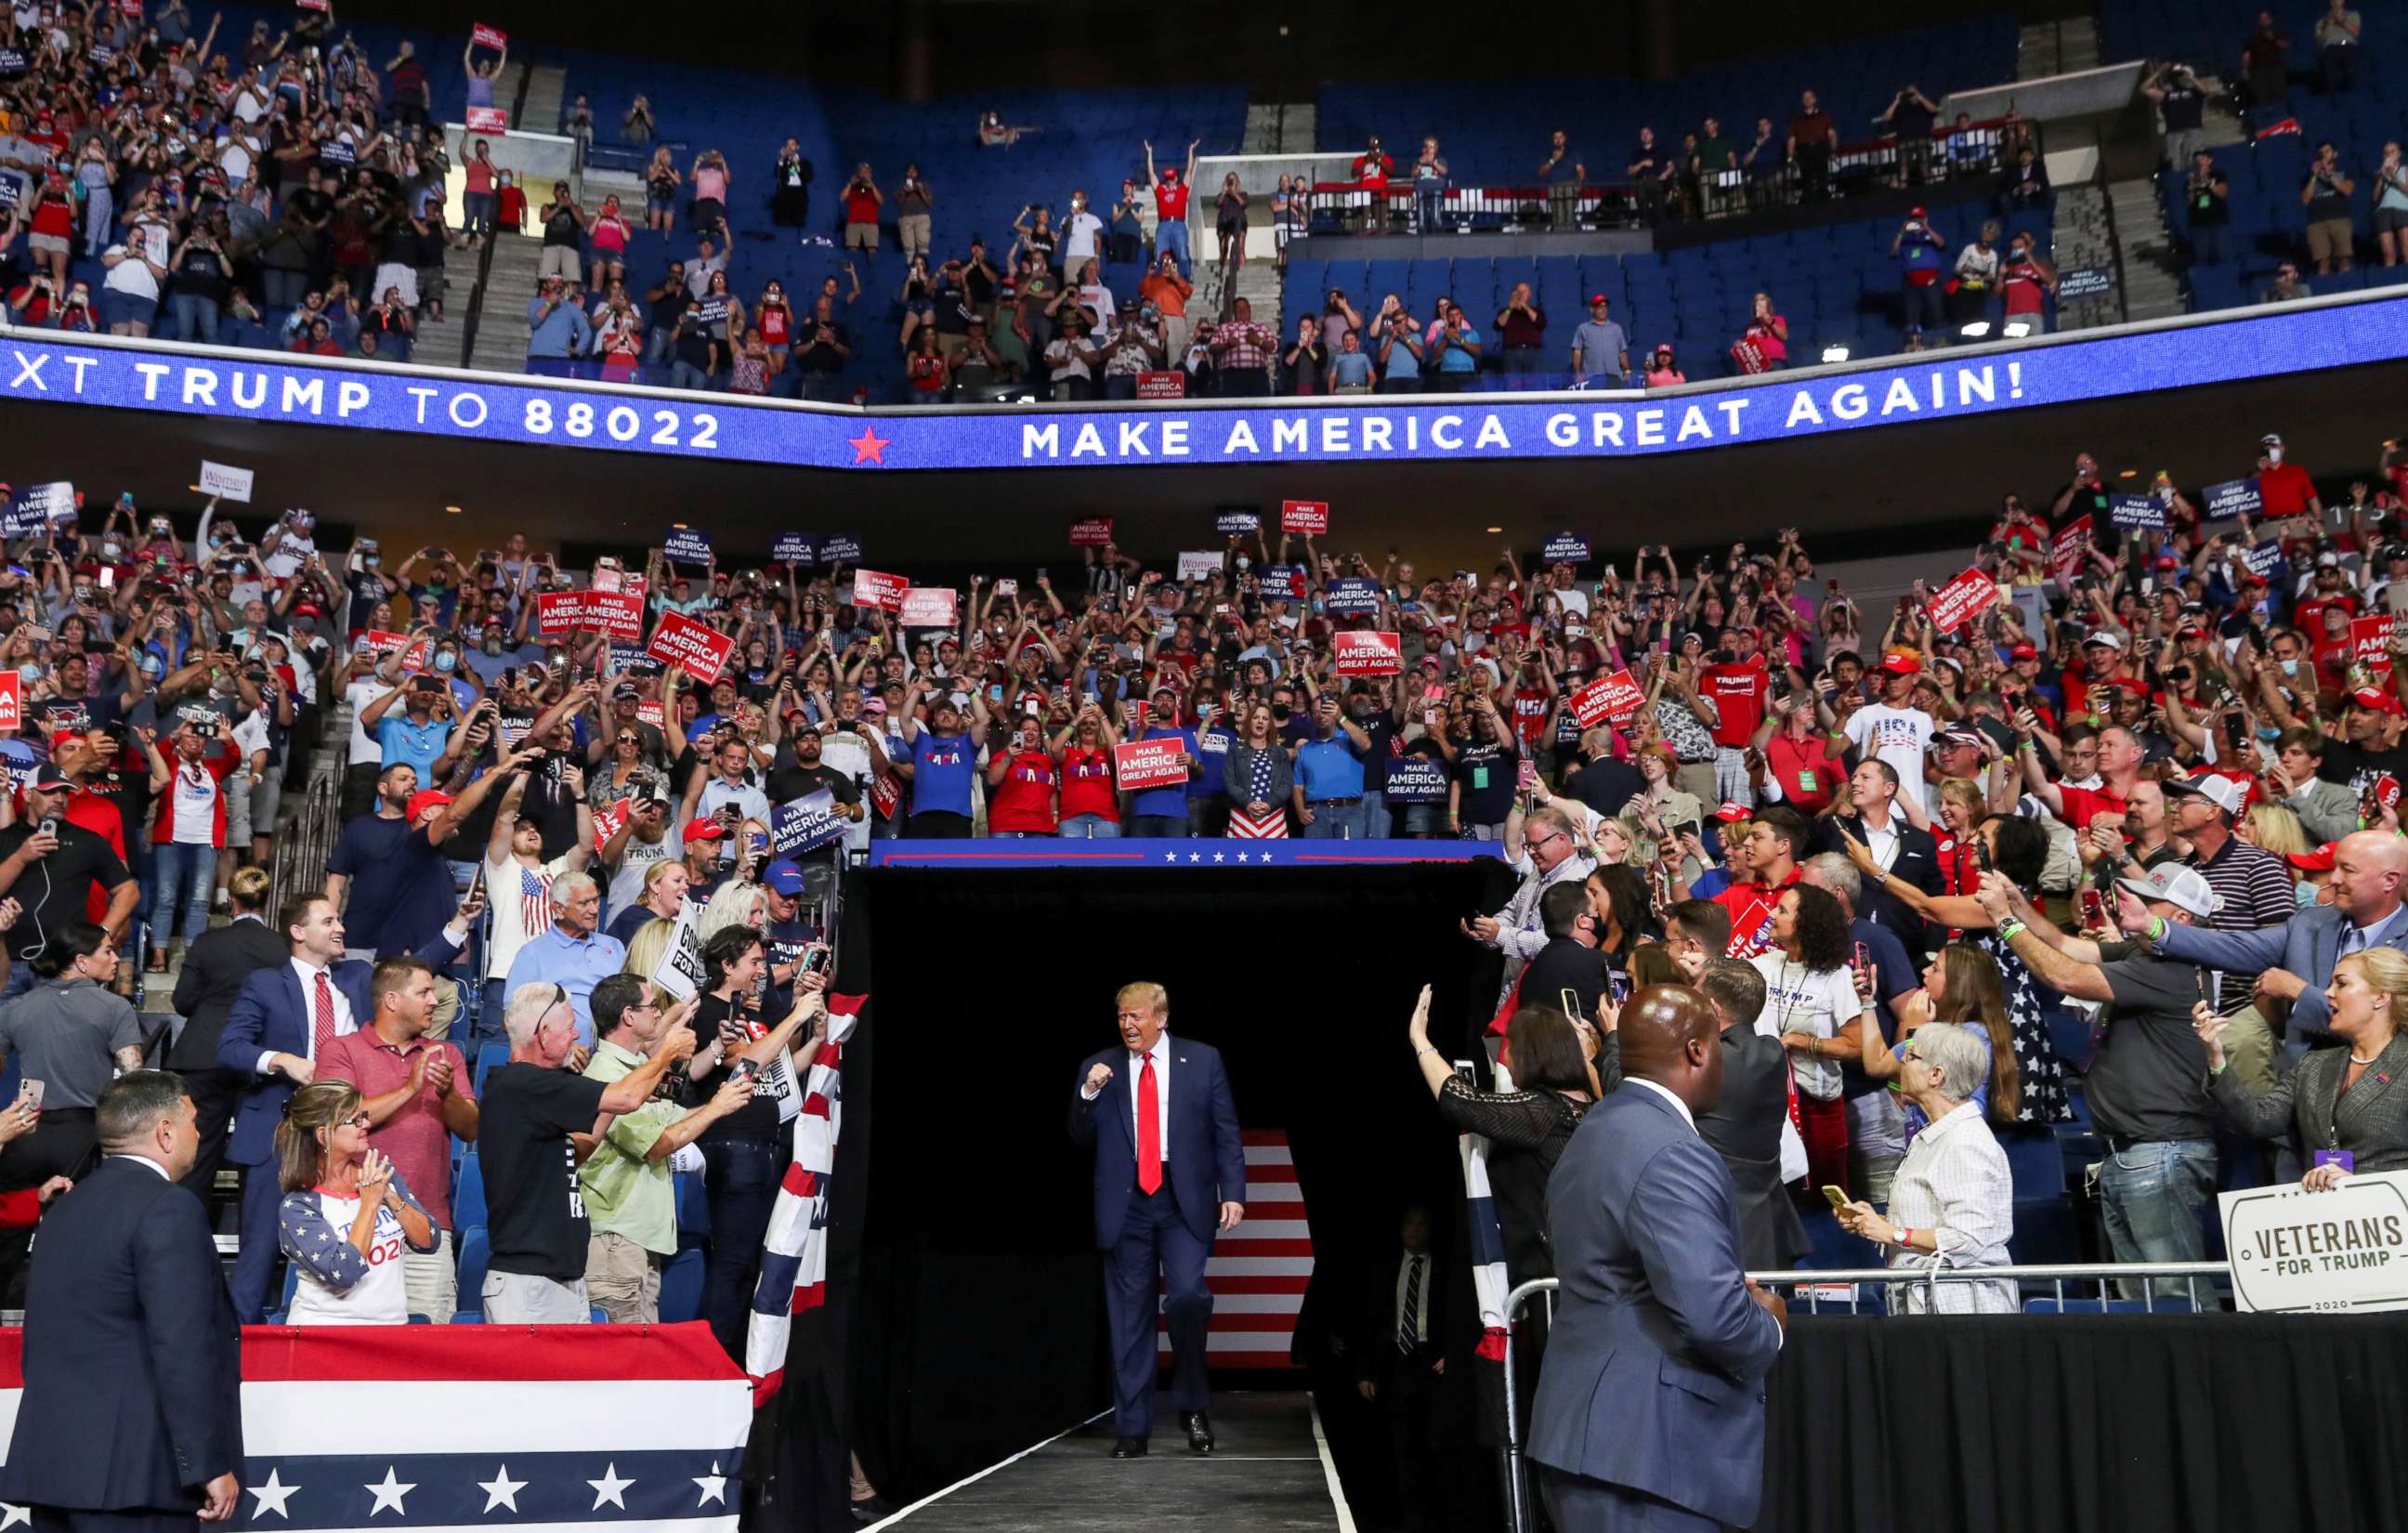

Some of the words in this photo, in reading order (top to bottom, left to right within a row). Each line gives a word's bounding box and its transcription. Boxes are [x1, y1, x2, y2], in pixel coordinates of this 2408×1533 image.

[2060, 276, 2107, 289] AMERICA
[1140, 382, 1182, 391] AMERICA
[135, 362, 370, 417] TRUMP
[407, 387, 488, 428] TO
[524, 399, 719, 449] 88022
[1022, 420, 1190, 458] MAKE
[1224, 414, 1512, 454] AMERICA
[1545, 398, 1750, 448] GREAT
[1785, 360, 2024, 428] AGAIN!
[205, 469, 247, 488] Women
[2127, 499, 2149, 507] MAKE
[2209, 491, 2259, 510] AMERICA
[1285, 512, 1325, 521] AMERICA
[2113, 504, 2164, 518] AMERICA
[1217, 515, 1258, 524] AMERICA
[1072, 524, 1108, 532] AMERICA
[679, 533, 700, 542] MAKE
[829, 537, 846, 545] MAKE
[665, 538, 711, 552] AMERICA
[773, 544, 812, 553] AMERICA
[820, 543, 859, 556] AMERICA
[1545, 543, 1587, 552] AMERICA
[664, 547, 687, 557] GREAT
[688, 550, 711, 558] AGAIN
[1182, 559, 1219, 568] Women
[871, 577, 893, 586] MAKE
[1329, 590, 1375, 600] AMERICA
[1938, 581, 1964, 601] MAKE
[556, 597, 578, 606] MAKE
[600, 597, 625, 608] MAKE
[1932, 577, 1987, 620] AMERICA
[542, 605, 582, 618] AMERIC
[902, 600, 953, 611] AMERICA
[584, 605, 638, 622] AMERICA
[1941, 605, 1967, 628] GREAT
[542, 618, 570, 627] GREAT
[584, 616, 607, 626] GREAT
[609, 620, 638, 631] AGAIN
[681, 625, 710, 643] MAKE
[657, 628, 719, 664] AMERICA
[653, 641, 686, 659] GREAT
[685, 656, 715, 674] AGAIN
[1338, 647, 1397, 659] AMERICA
[1338, 660, 1368, 668] GREAT
[1716, 676, 1753, 686] TRUMP
[1586, 681, 1614, 697] MAKE
[1577, 684, 1636, 714] AMERICA
[1580, 703, 1609, 722] GREAT
[1610, 691, 1641, 707] AGAIN
[1135, 746, 1164, 757] MAKE
[7, 766, 30, 780] AKE
[1120, 771, 1153, 782] GREAT
[1155, 764, 1187, 777] AGAIN
[1405, 765, 1431, 773] MAKE
[1388, 773, 1446, 785] AMERICA
[1387, 786, 1416, 794] GREAT
[1417, 786, 1446, 794] AGAIN
[783, 803, 812, 821] MAKE
[776, 834, 808, 853] GREAT
[810, 818, 842, 838] AGAIN
[1769, 987, 1813, 1002] TRUMP
[2255, 1214, 2403, 1260] VETERANS
[2275, 1258, 2313, 1277] FOR
[2319, 1251, 2390, 1273] TRUMP
[2314, 1300, 2348, 1311] 2020
